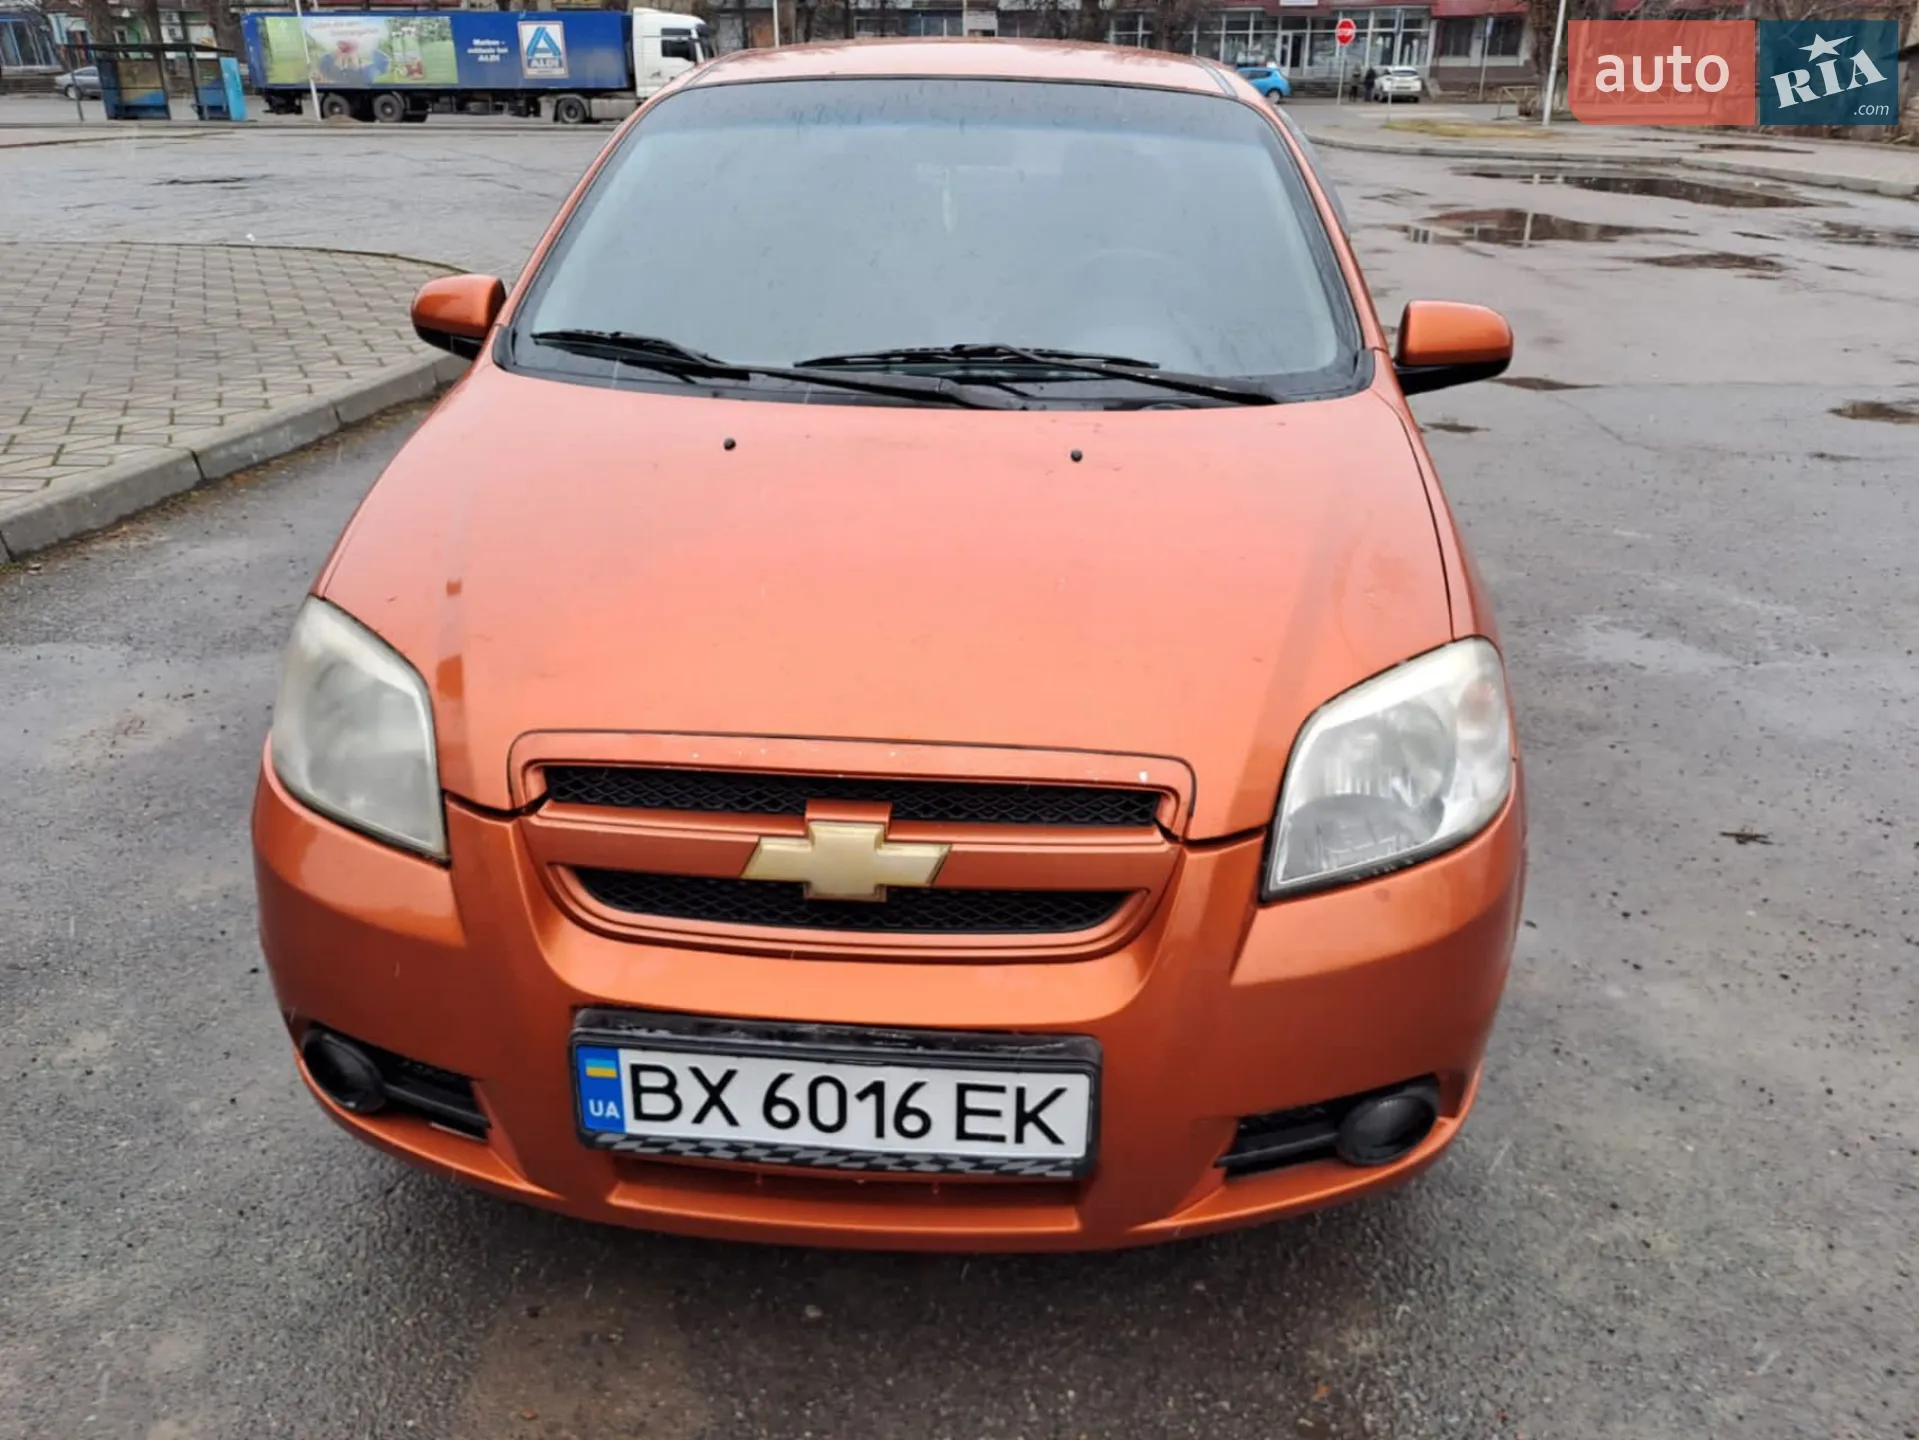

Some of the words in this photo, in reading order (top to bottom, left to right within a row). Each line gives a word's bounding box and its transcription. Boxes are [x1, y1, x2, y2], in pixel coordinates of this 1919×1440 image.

[588, 1098, 621, 1120] UA
[629, 1062, 741, 1128] BX
[761, 1072, 933, 1141] 6016
[955, 1082, 1069, 1146] EK
